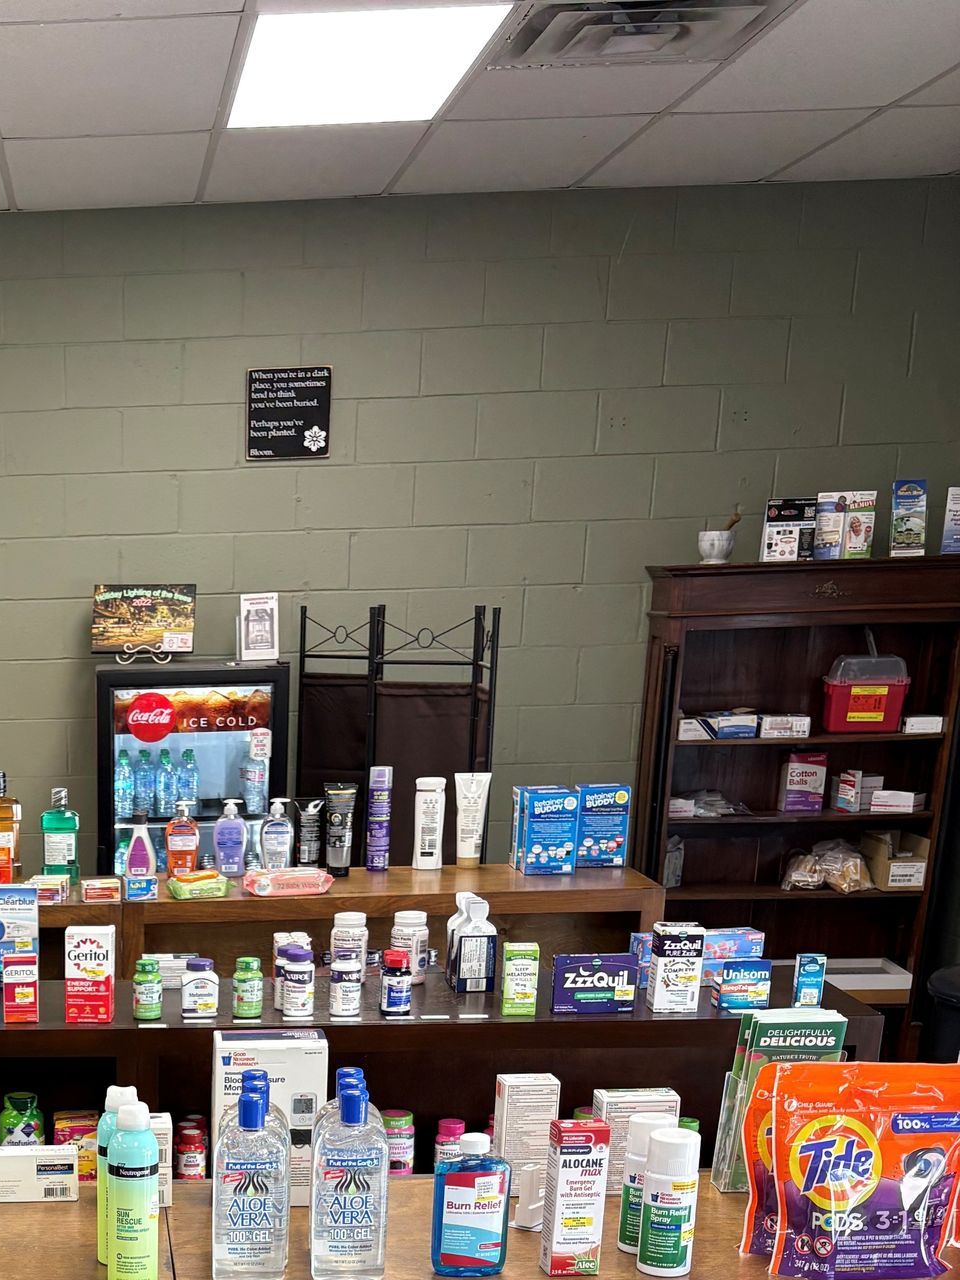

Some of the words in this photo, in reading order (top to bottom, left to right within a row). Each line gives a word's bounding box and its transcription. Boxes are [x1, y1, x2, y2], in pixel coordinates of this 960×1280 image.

[274, 371, 296, 380] you're
[273, 382, 287, 390] you
[288, 380, 326, 388] sometimes
[251, 391, 267, 399] tend
[96, 591, 122, 601] Holiday
[123, 589, 151, 598] Lighting
[184, 718, 207, 727] ICE
[216, 717, 256, 726] COLD
[790, 770, 818, 778] Cotton
[789, 778, 808, 786] Balls
[586, 798, 614, 808] BUDDY
[535, 804, 563, 814] BUDDY
[664, 940, 702, 951] ZzzQuil
[68, 949, 109, 962] Geritol
[564, 971, 628, 988] ZzzQuil
[724, 969, 769, 980] Unisom
[760, 1037, 836, 1046] DELICIOUS
[897, 1119, 930, 1129] 100%
[562, 1158, 604, 1169] ALOCANE
[799, 1139, 874, 1195] Tide
[580, 1168, 602, 1177] max
[229, 1198, 272, 1213] ALOE
[329, 1195, 373, 1210] ALOE
[446, 1201, 472, 1210] Burn
[474, 1200, 501, 1210] Relief
[116, 1210, 130, 1218] SUN
[329, 1210, 373, 1225] VERA
[650, 1214, 671, 1223] Spray
[227, 1213, 272, 1227] VERA
[253, 1229, 272, 1241] GEL
